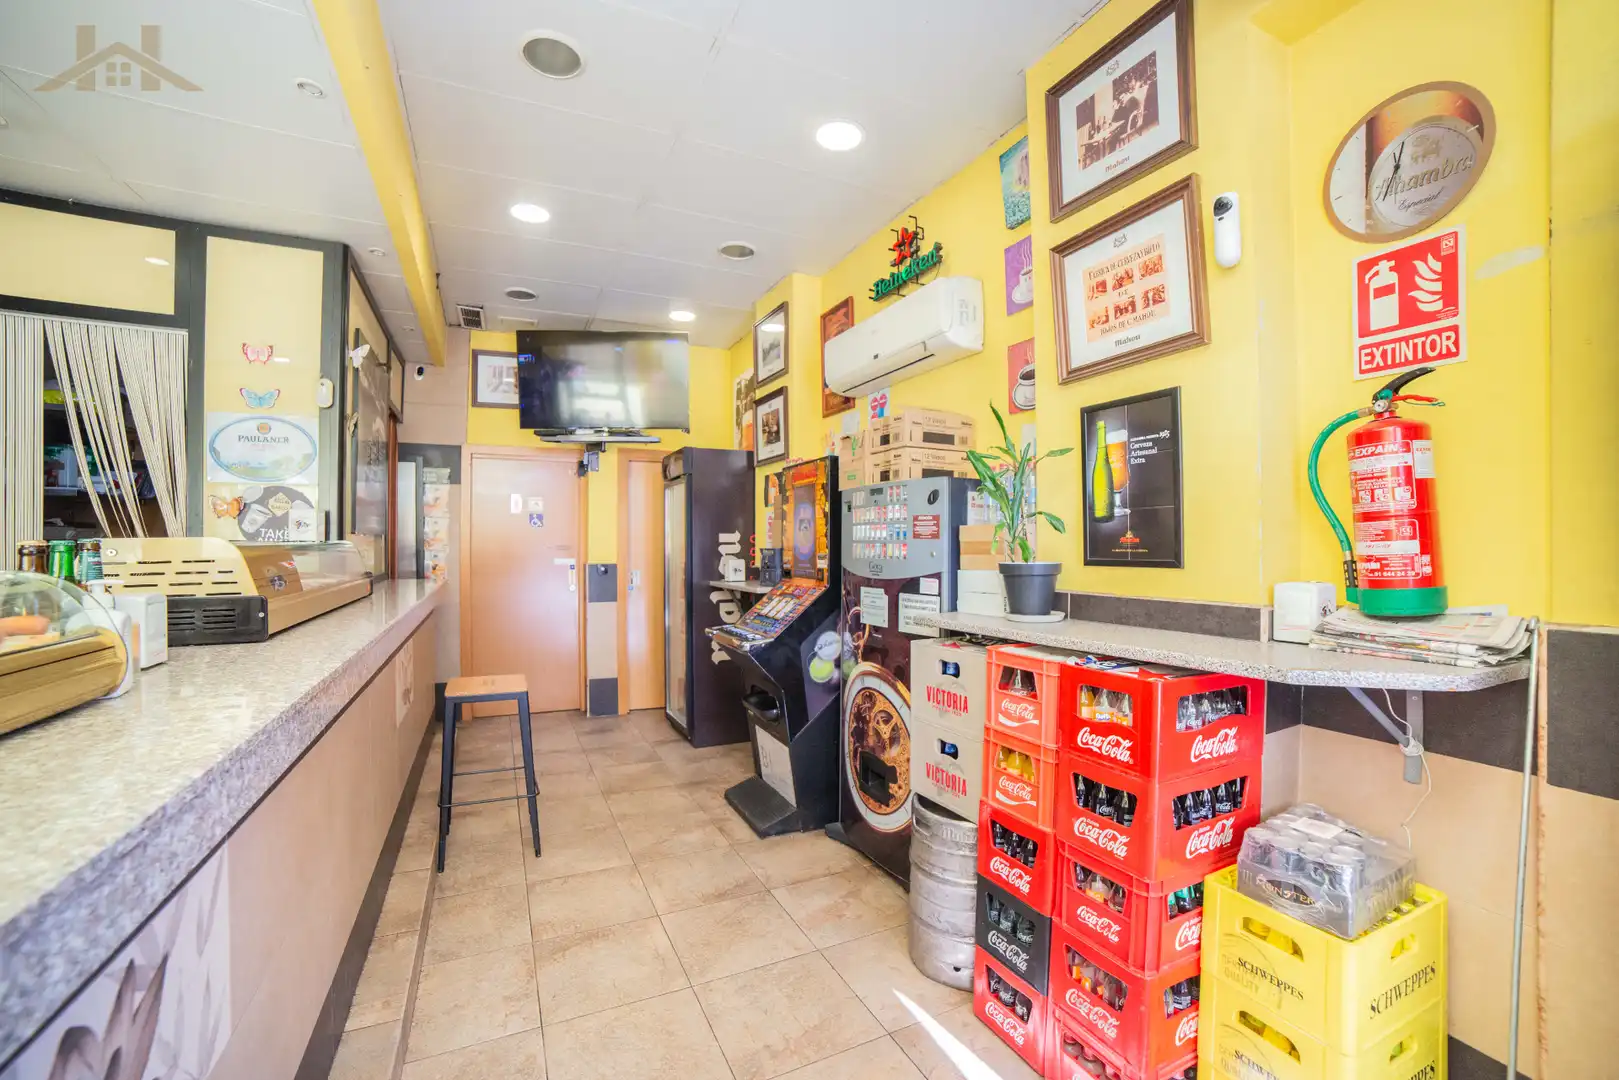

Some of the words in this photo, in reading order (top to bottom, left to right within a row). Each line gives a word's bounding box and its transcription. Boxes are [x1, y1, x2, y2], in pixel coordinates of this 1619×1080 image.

[1398, 186, 1445, 212] Especial
[873, 247, 938, 301] Heineken
[1360, 331, 1457, 371] EXTINTOR
[238, 434, 289, 444] PAULANER
[1130, 441, 1153, 449] Cerveza
[1130, 447, 1158, 457] Artesanal
[1355, 444, 1399, 457] EXPAIN
[1130, 457, 1146, 465] Extra
[926, 685, 968, 714] VICTORIA
[1001, 698, 1036, 720] Coca-Cola
[1077, 727, 1133, 763] Coca-Cola
[1190, 727, 1239, 763] Coca-Cola
[925, 762, 967, 797] VICTORIA
[998, 775, 1032, 801] Coca-Cola
[1074, 817, 1130, 857] Coca-Cola
[1185, 817, 1235, 860] Coca-Cola
[990, 856, 1032, 893] Coca-Cola
[1076, 905, 1122, 943] Coca-Cola
[987, 930, 1030, 971] Coca-Cola
[1237, 957, 1304, 1001] SCHWEPPES
[1369, 961, 1435, 1019] SCHWEPPES
[985, 1001, 1026, 1045] Coca-Cola
[1066, 988, 1120, 1039] Coca-Cola
